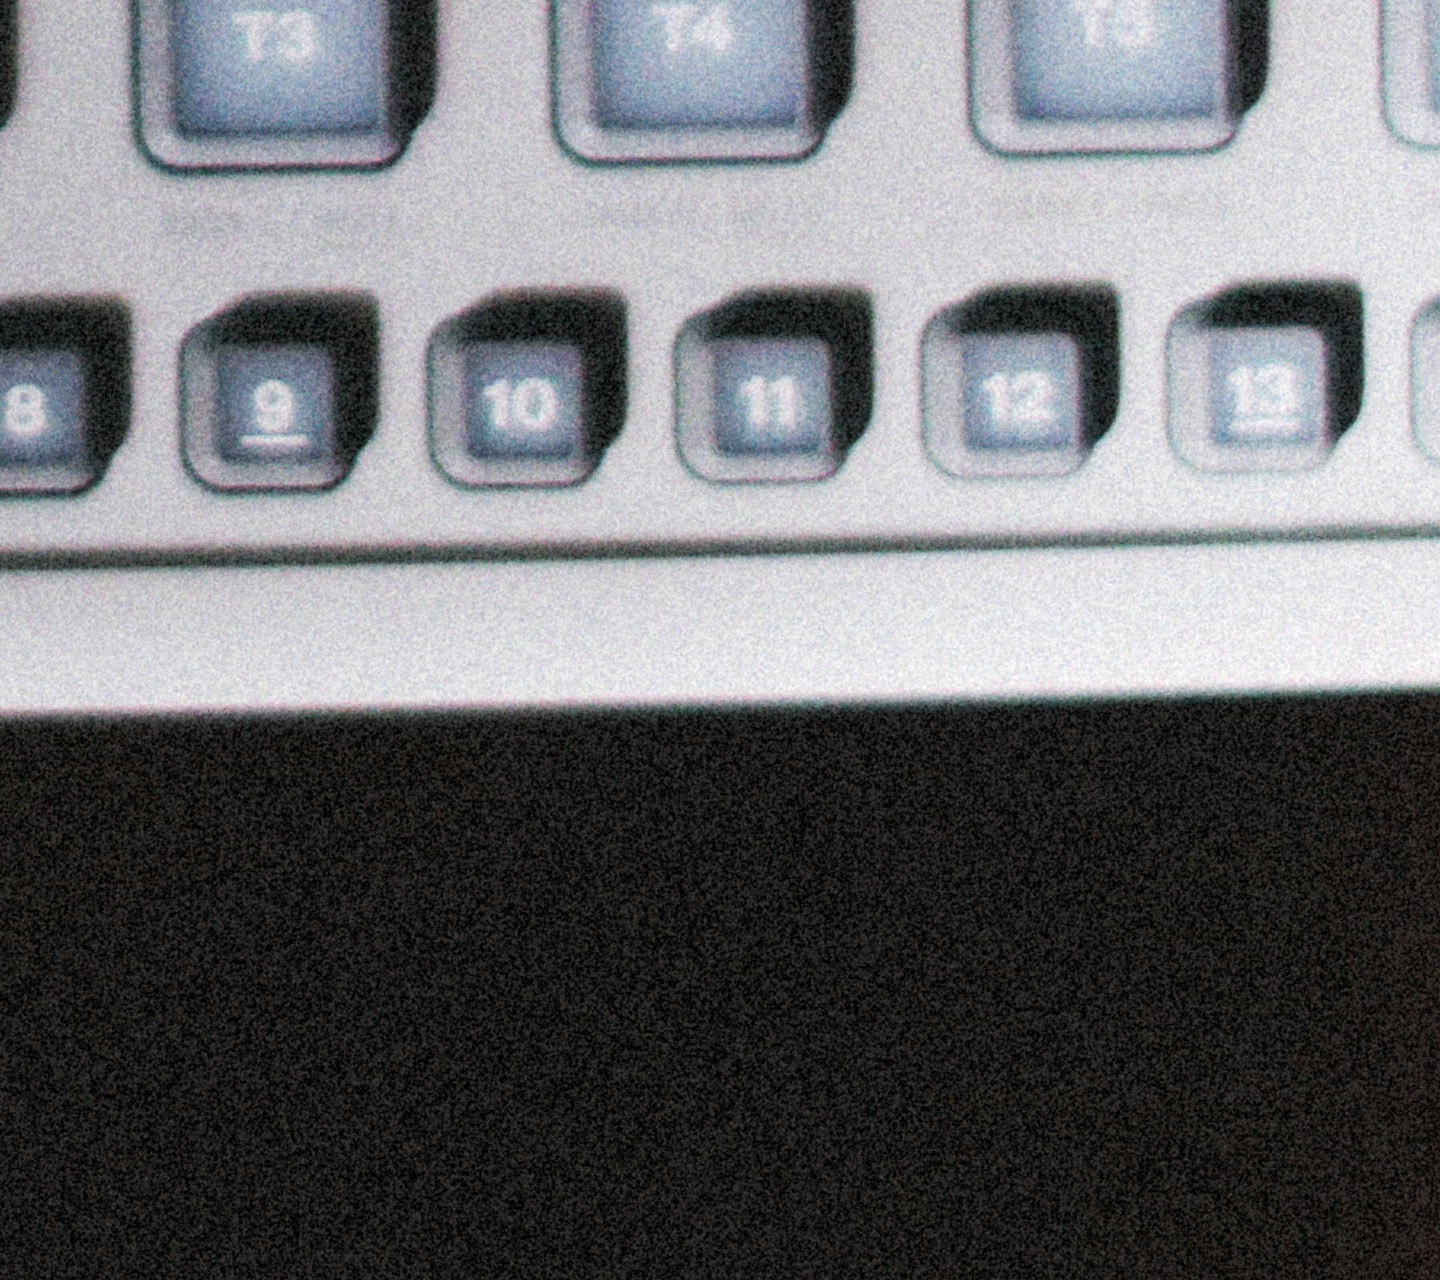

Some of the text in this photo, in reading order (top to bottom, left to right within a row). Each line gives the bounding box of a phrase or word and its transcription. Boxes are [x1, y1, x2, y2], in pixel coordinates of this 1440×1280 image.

[233, 10, 321, 66] T3
[653, 2, 735, 55] T4
[3, 384, 49, 440] 8
[253, 381, 295, 432] 9
[484, 377, 560, 433] 10
[741, 375, 803, 429] 11
[983, 370, 1056, 429] 12
[1230, 362, 1301, 414] 13
